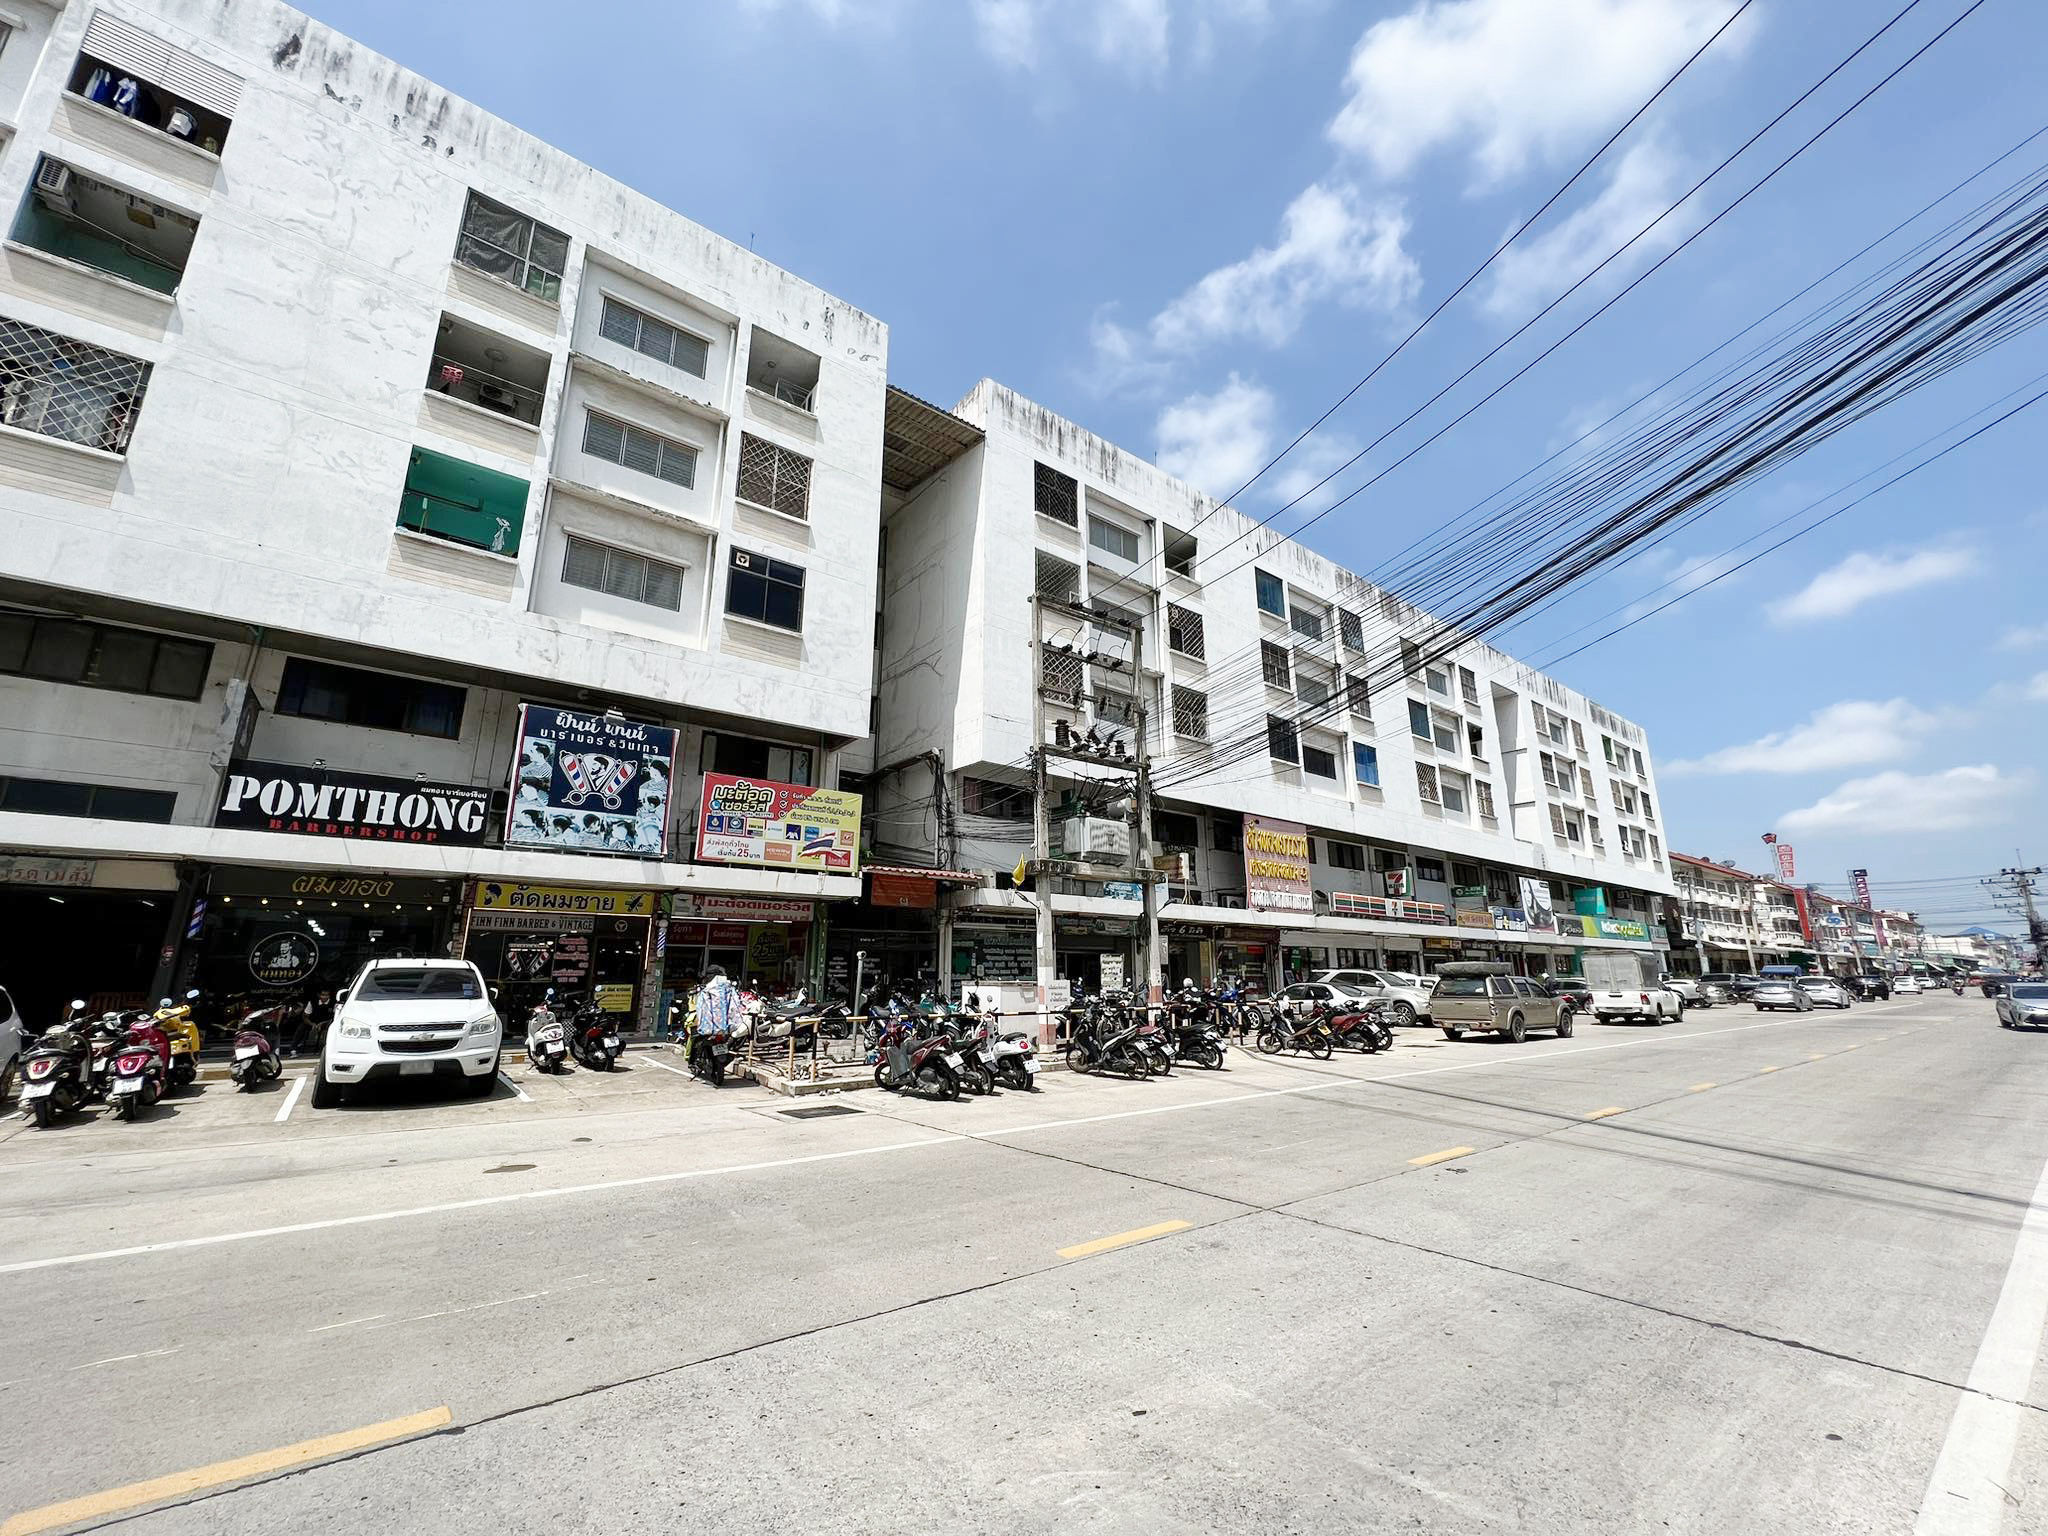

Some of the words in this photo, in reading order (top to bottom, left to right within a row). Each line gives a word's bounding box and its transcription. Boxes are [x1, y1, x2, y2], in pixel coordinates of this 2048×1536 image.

[222, 775, 486, 833] POMTHONG
[268, 819, 439, 842] BARBERSHOP
[737, 848, 749, 858] 25
[291, 875, 394, 897] ผมทอง
[509, 884, 616, 911] ตัดผมชาย
[471, 916, 492, 927] FINN
[494, 917, 515, 928] FINN
[517, 917, 550, 929] BARBER
[559, 919, 593, 930] VINTAGE
